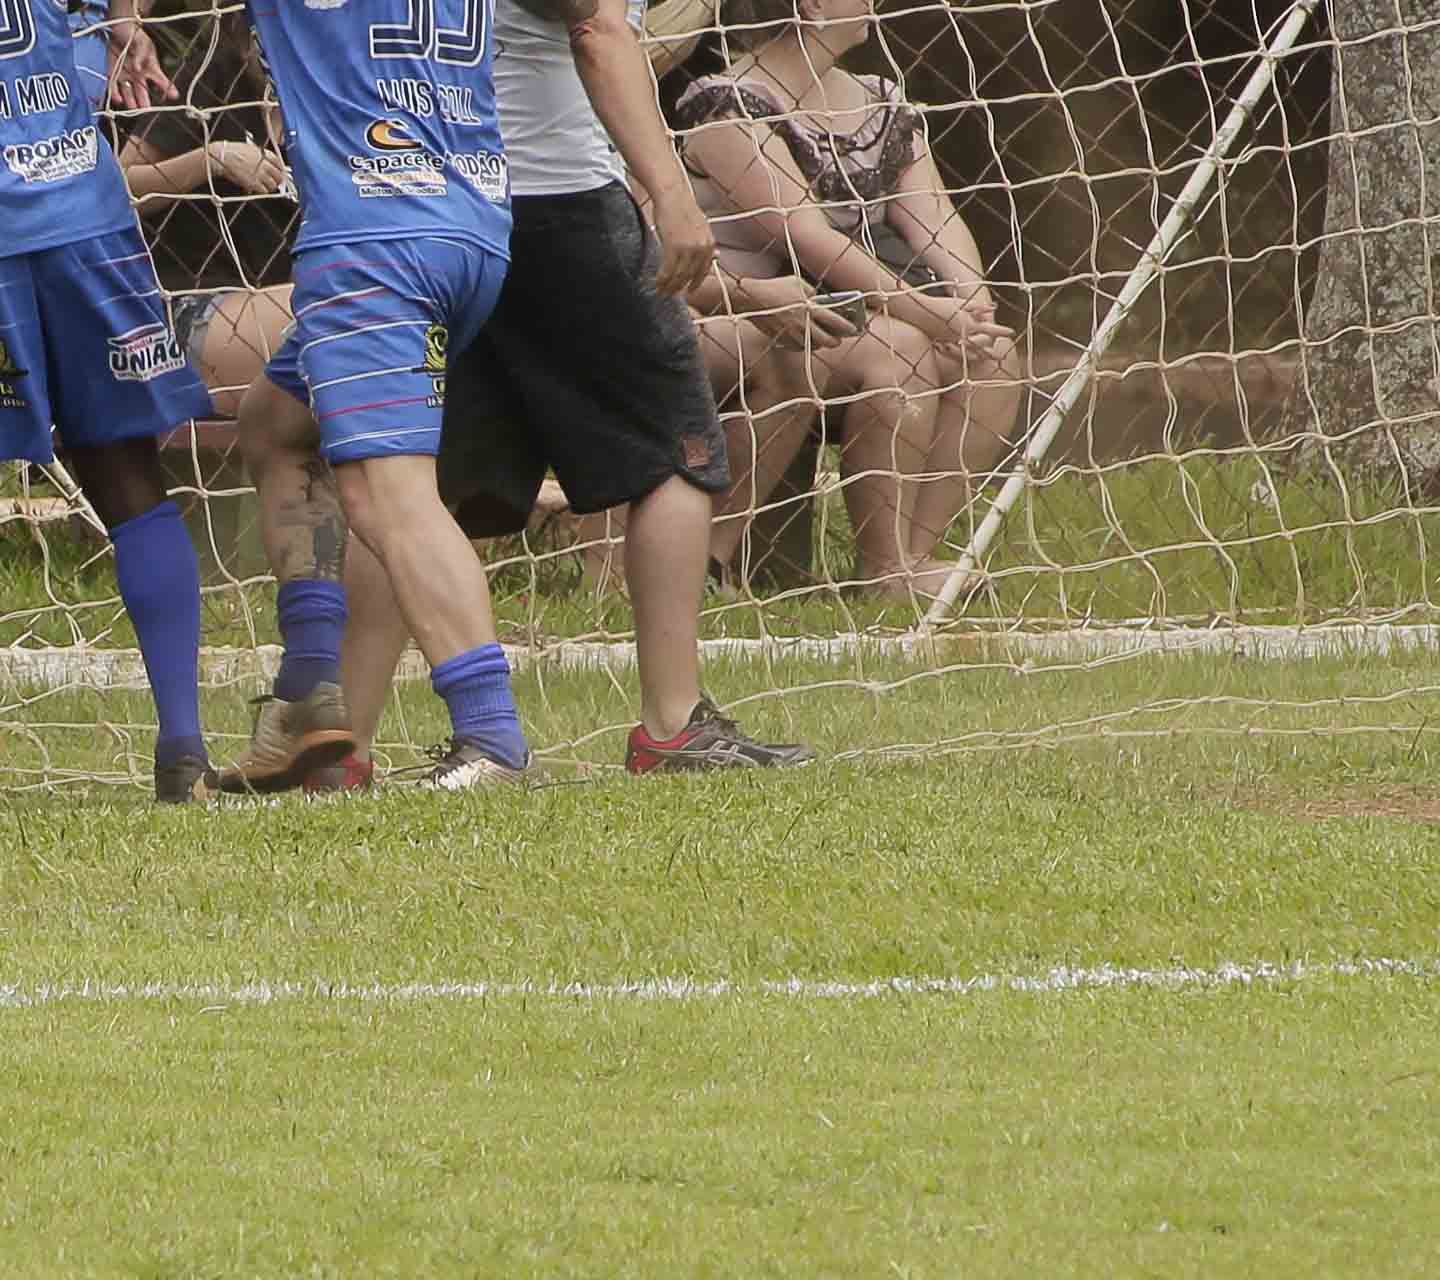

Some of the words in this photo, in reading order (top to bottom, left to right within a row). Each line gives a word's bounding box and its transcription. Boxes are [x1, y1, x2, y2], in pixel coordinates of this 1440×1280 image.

[16, 72, 70, 115] MITO
[377, 79, 434, 117] LUIS
[349, 152, 444, 173] Capacete
